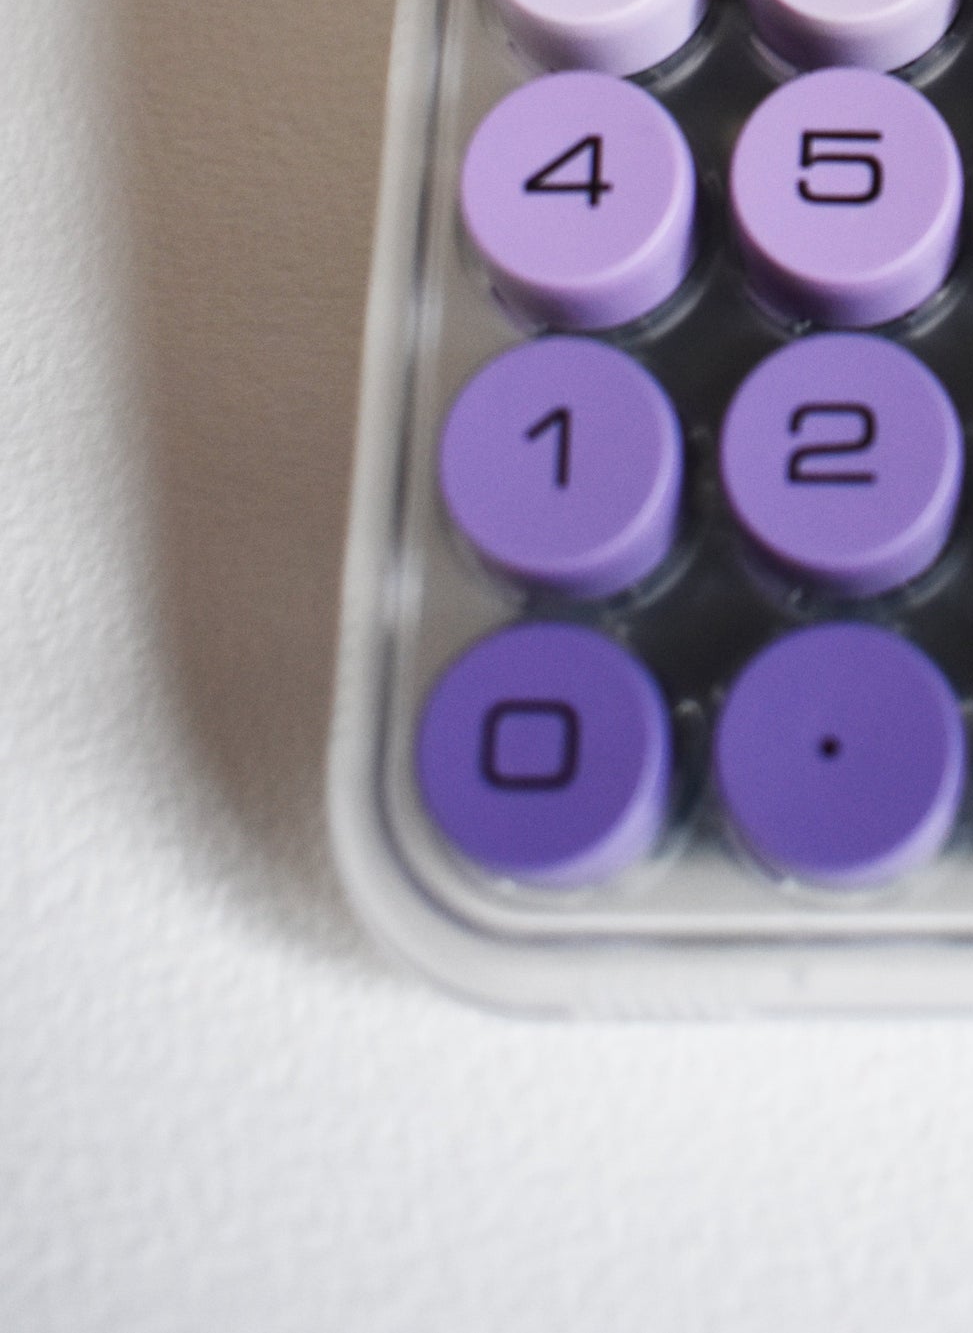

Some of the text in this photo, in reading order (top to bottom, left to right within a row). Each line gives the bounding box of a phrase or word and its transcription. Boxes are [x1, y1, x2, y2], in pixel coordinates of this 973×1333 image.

[522, 134, 613, 209] 4
[796, 130, 884, 206] 5
[524, 406, 572, 490] 1
[785, 402, 878, 486] 2
[480, 699, 581, 794] 0
